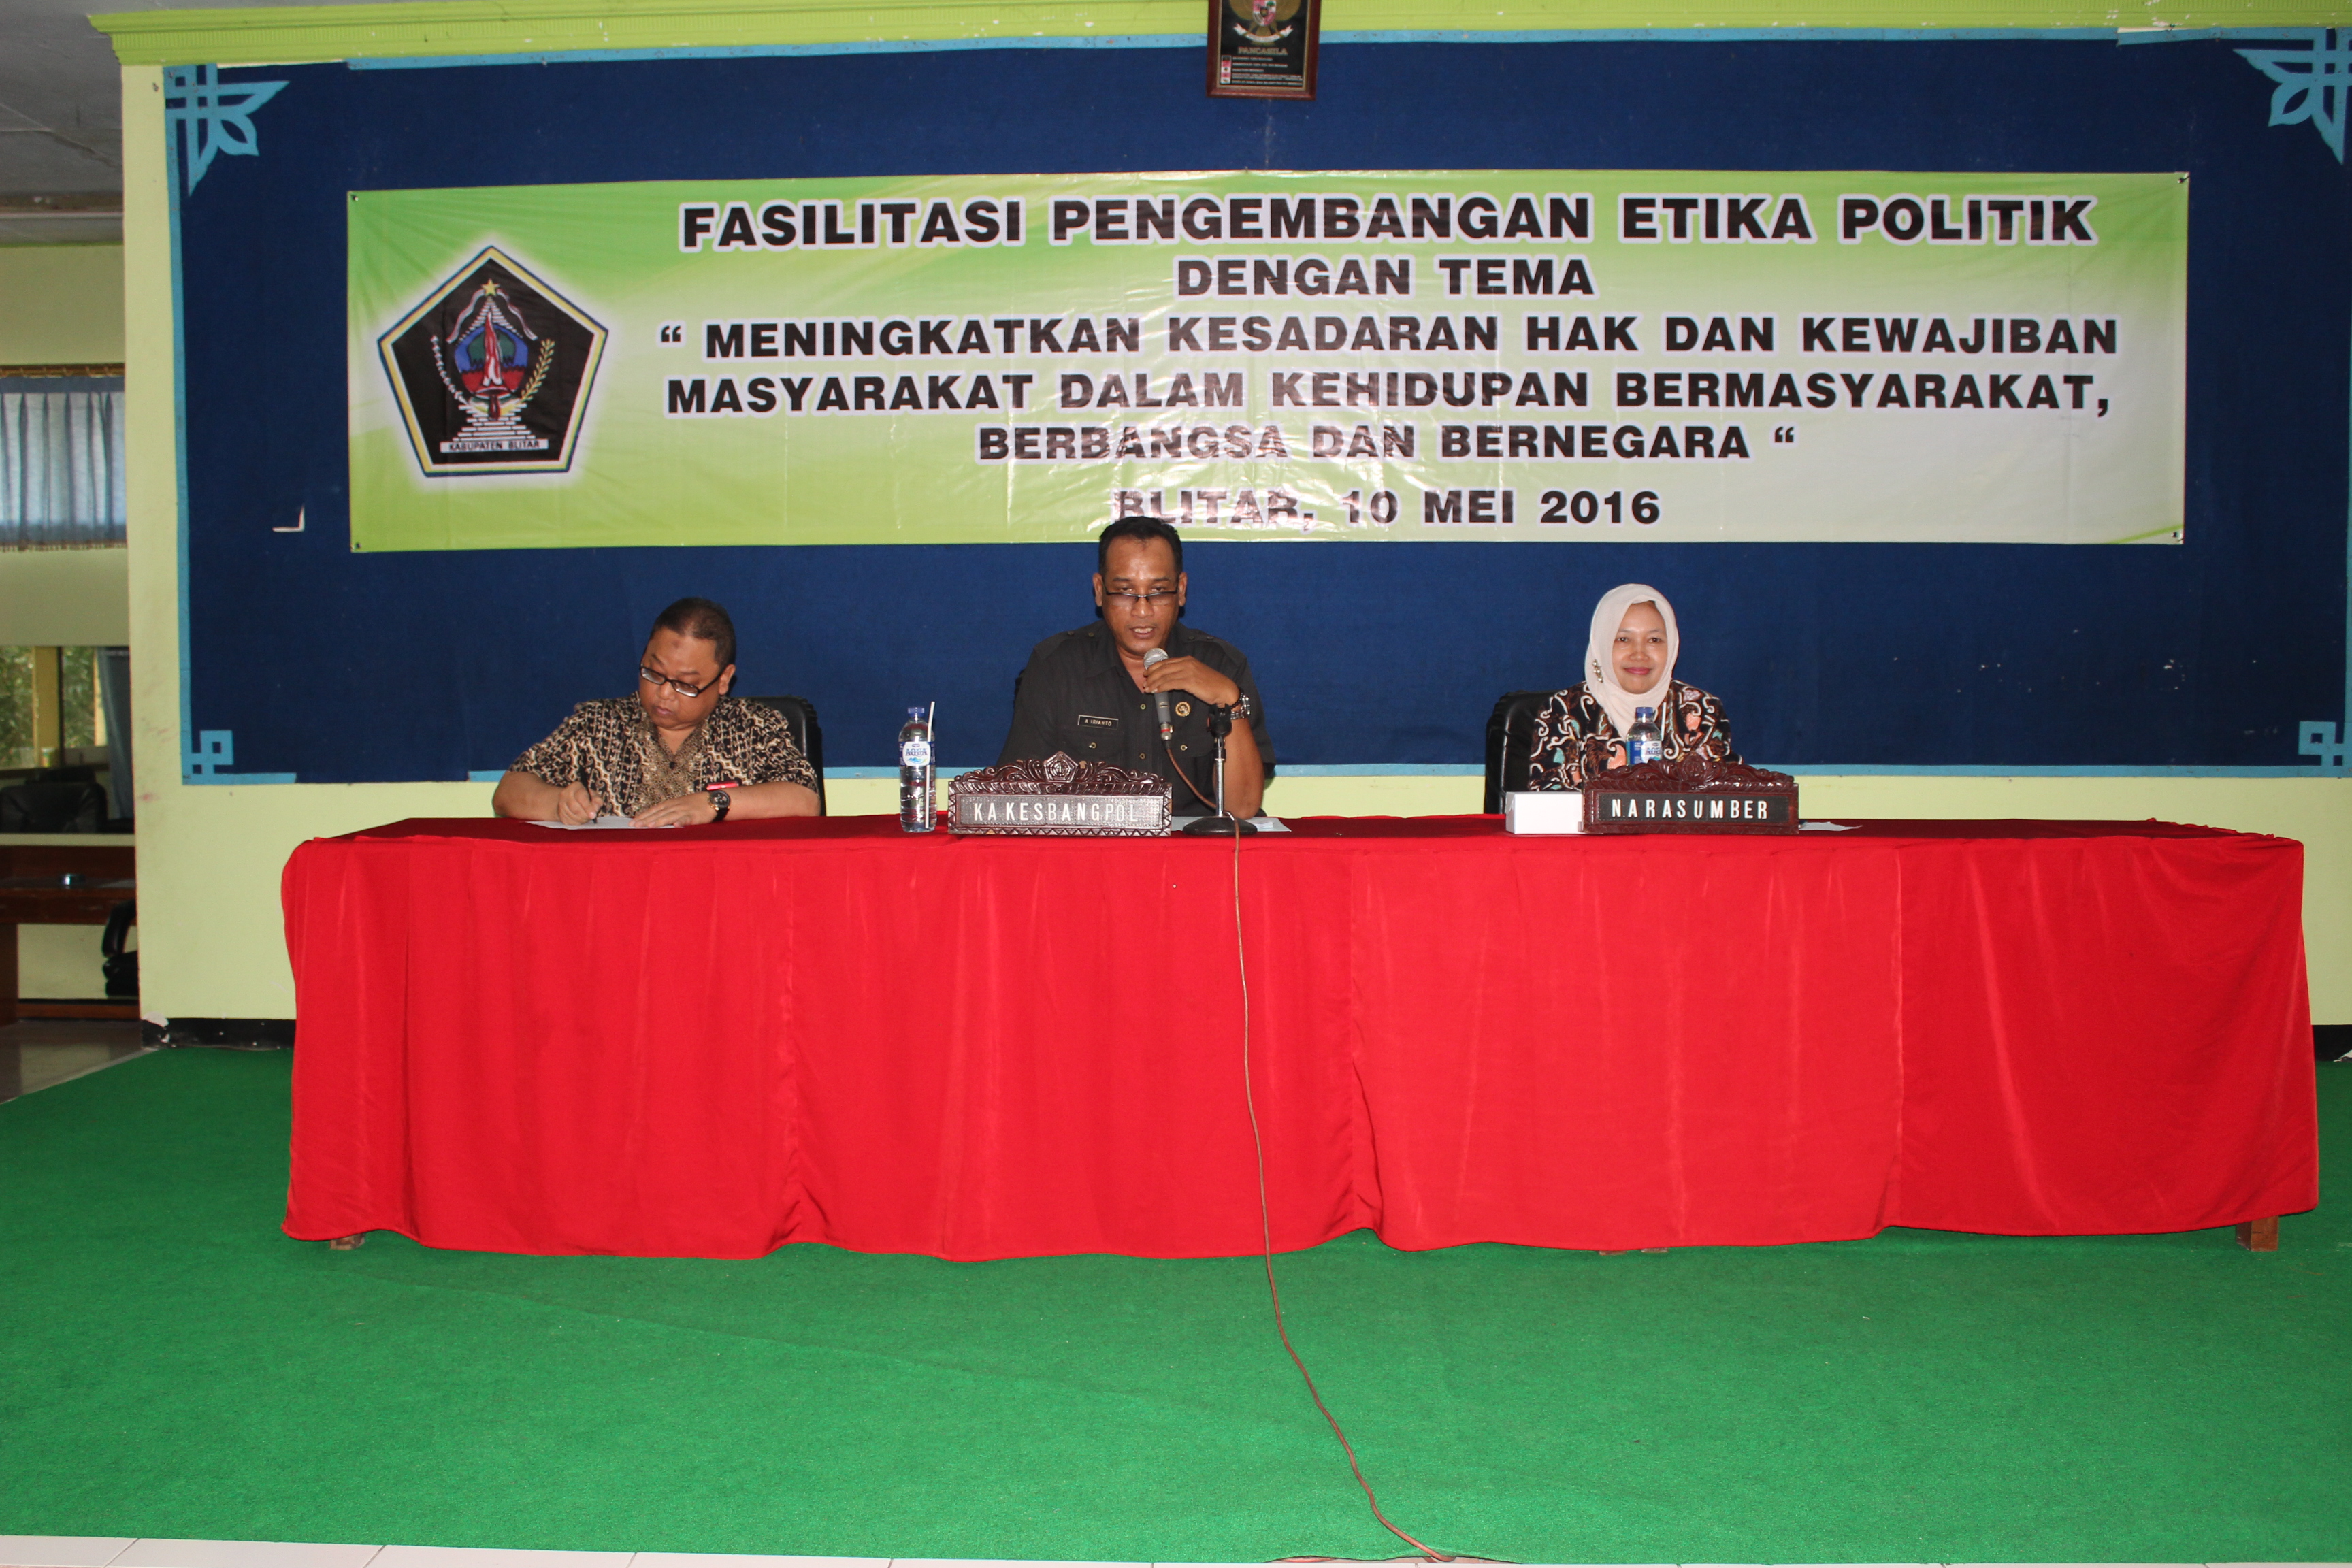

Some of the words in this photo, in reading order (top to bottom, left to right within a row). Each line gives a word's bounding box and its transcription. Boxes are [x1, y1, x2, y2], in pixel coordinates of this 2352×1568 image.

[1237, 46, 1288, 55] PANCASILA
[684, 200, 1020, 248] FASILITASI
[1054, 197, 1588, 241] PENGEMBANGAN
[1624, 198, 1812, 239] ETIKA
[1843, 198, 2093, 241] POLITIK
[1179, 259, 1410, 295] DENGAN
[1439, 259, 1594, 295] TEMA
[706, 318, 1140, 358] MENINGKATKAN
[1170, 316, 1497, 351] KESADARAN
[1527, 316, 1638, 351] HAK
[1666, 317, 1774, 352] DAN
[1803, 317, 2117, 354] KEWAJIBAN
[668, 374, 1033, 414] MASYARAKAT
[1061, 373, 1241, 408] DALAM
[1273, 372, 1587, 407] KEHIDUPAN
[1616, 372, 2109, 418] BERMASYARAKAT,
[448, 441, 502, 451] KABUPATEN
[508, 440, 540, 449] BLITAR
[980, 426, 1288, 459] BERBANGSA
[1313, 425, 1415, 457] DAN
[1441, 425, 1750, 459] BERNEGARA
[1114, 490, 1315, 532] BLITAR,
[1342, 490, 1398, 524] 10
[1424, 490, 1514, 523] MEI
[1540, 491, 1660, 525] 2016
[905, 748, 928, 756] AQUA
[974, 803, 996, 821] KA
[1005, 802, 1139, 823] KESBANGPOL
[1611, 798, 1768, 819] NARASUMBER
